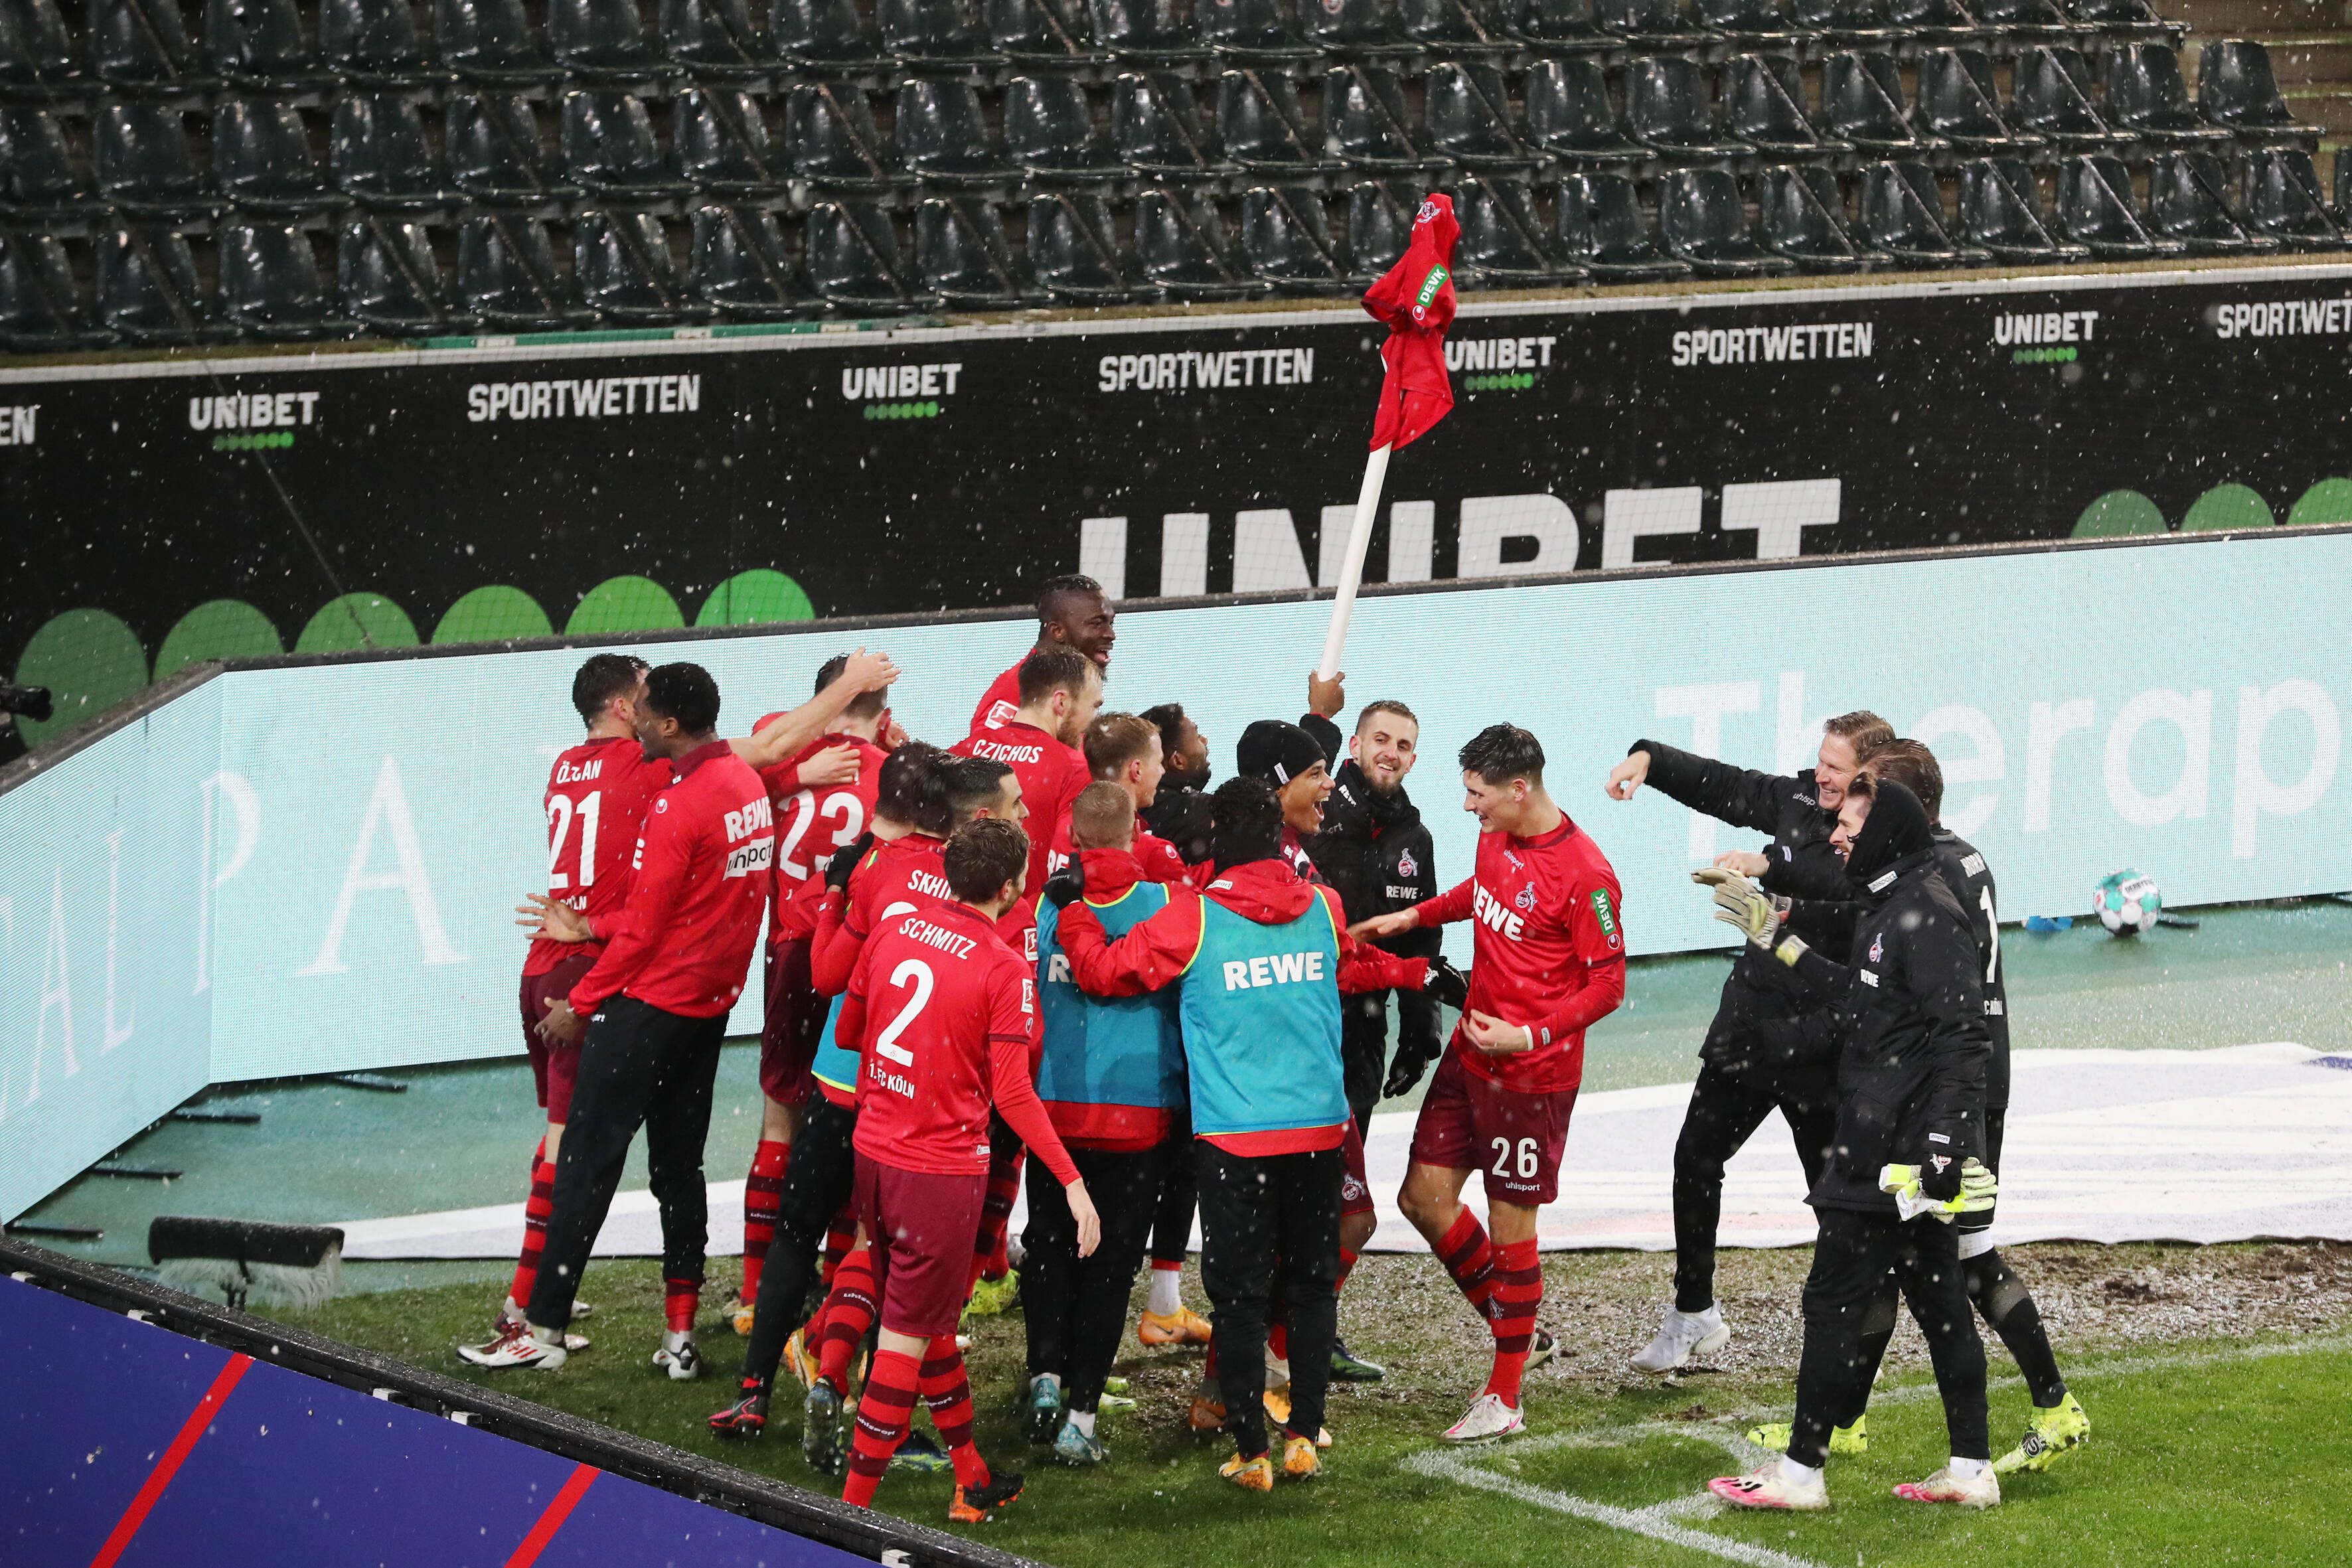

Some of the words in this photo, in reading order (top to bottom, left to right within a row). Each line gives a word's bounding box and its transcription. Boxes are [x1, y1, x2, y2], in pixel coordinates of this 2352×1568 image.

[1420, 269, 1445, 303] DEVK
[189, 391, 319, 431] UNIBET
[467, 374, 700, 422] SPORTWETTEN
[842, 363, 963, 400] UNIBET
[1098, 348, 1314, 392] SPORTWETTEN
[1445, 337, 1557, 371] UNIBET
[1672, 323, 1873, 366] SPORTWETTEN
[1994, 311, 2099, 346] UNIBET
[973, 739, 1044, 763] CZICHOS
[724, 796, 773, 844] REWE
[1792, 793, 1818, 811] uhlsp
[547, 791, 601, 890] 21
[777, 789, 864, 881] 23
[1503, 849, 1525, 870] uhlsport
[1386, 885, 1419, 900] REWE
[1595, 893, 1613, 931] DEVK
[899, 917, 977, 960] SCHMITZ
[1979, 885, 1999, 983] 1
[1223, 952, 1324, 991] REWE
[876, 959, 934, 1067] 2
[870, 1063, 886, 1087] 1.FC
[887, 1074, 915, 1099] KÖLN
[1491, 1137, 1538, 1178] 26
[1506, 1182, 1540, 1192] uhlsport
